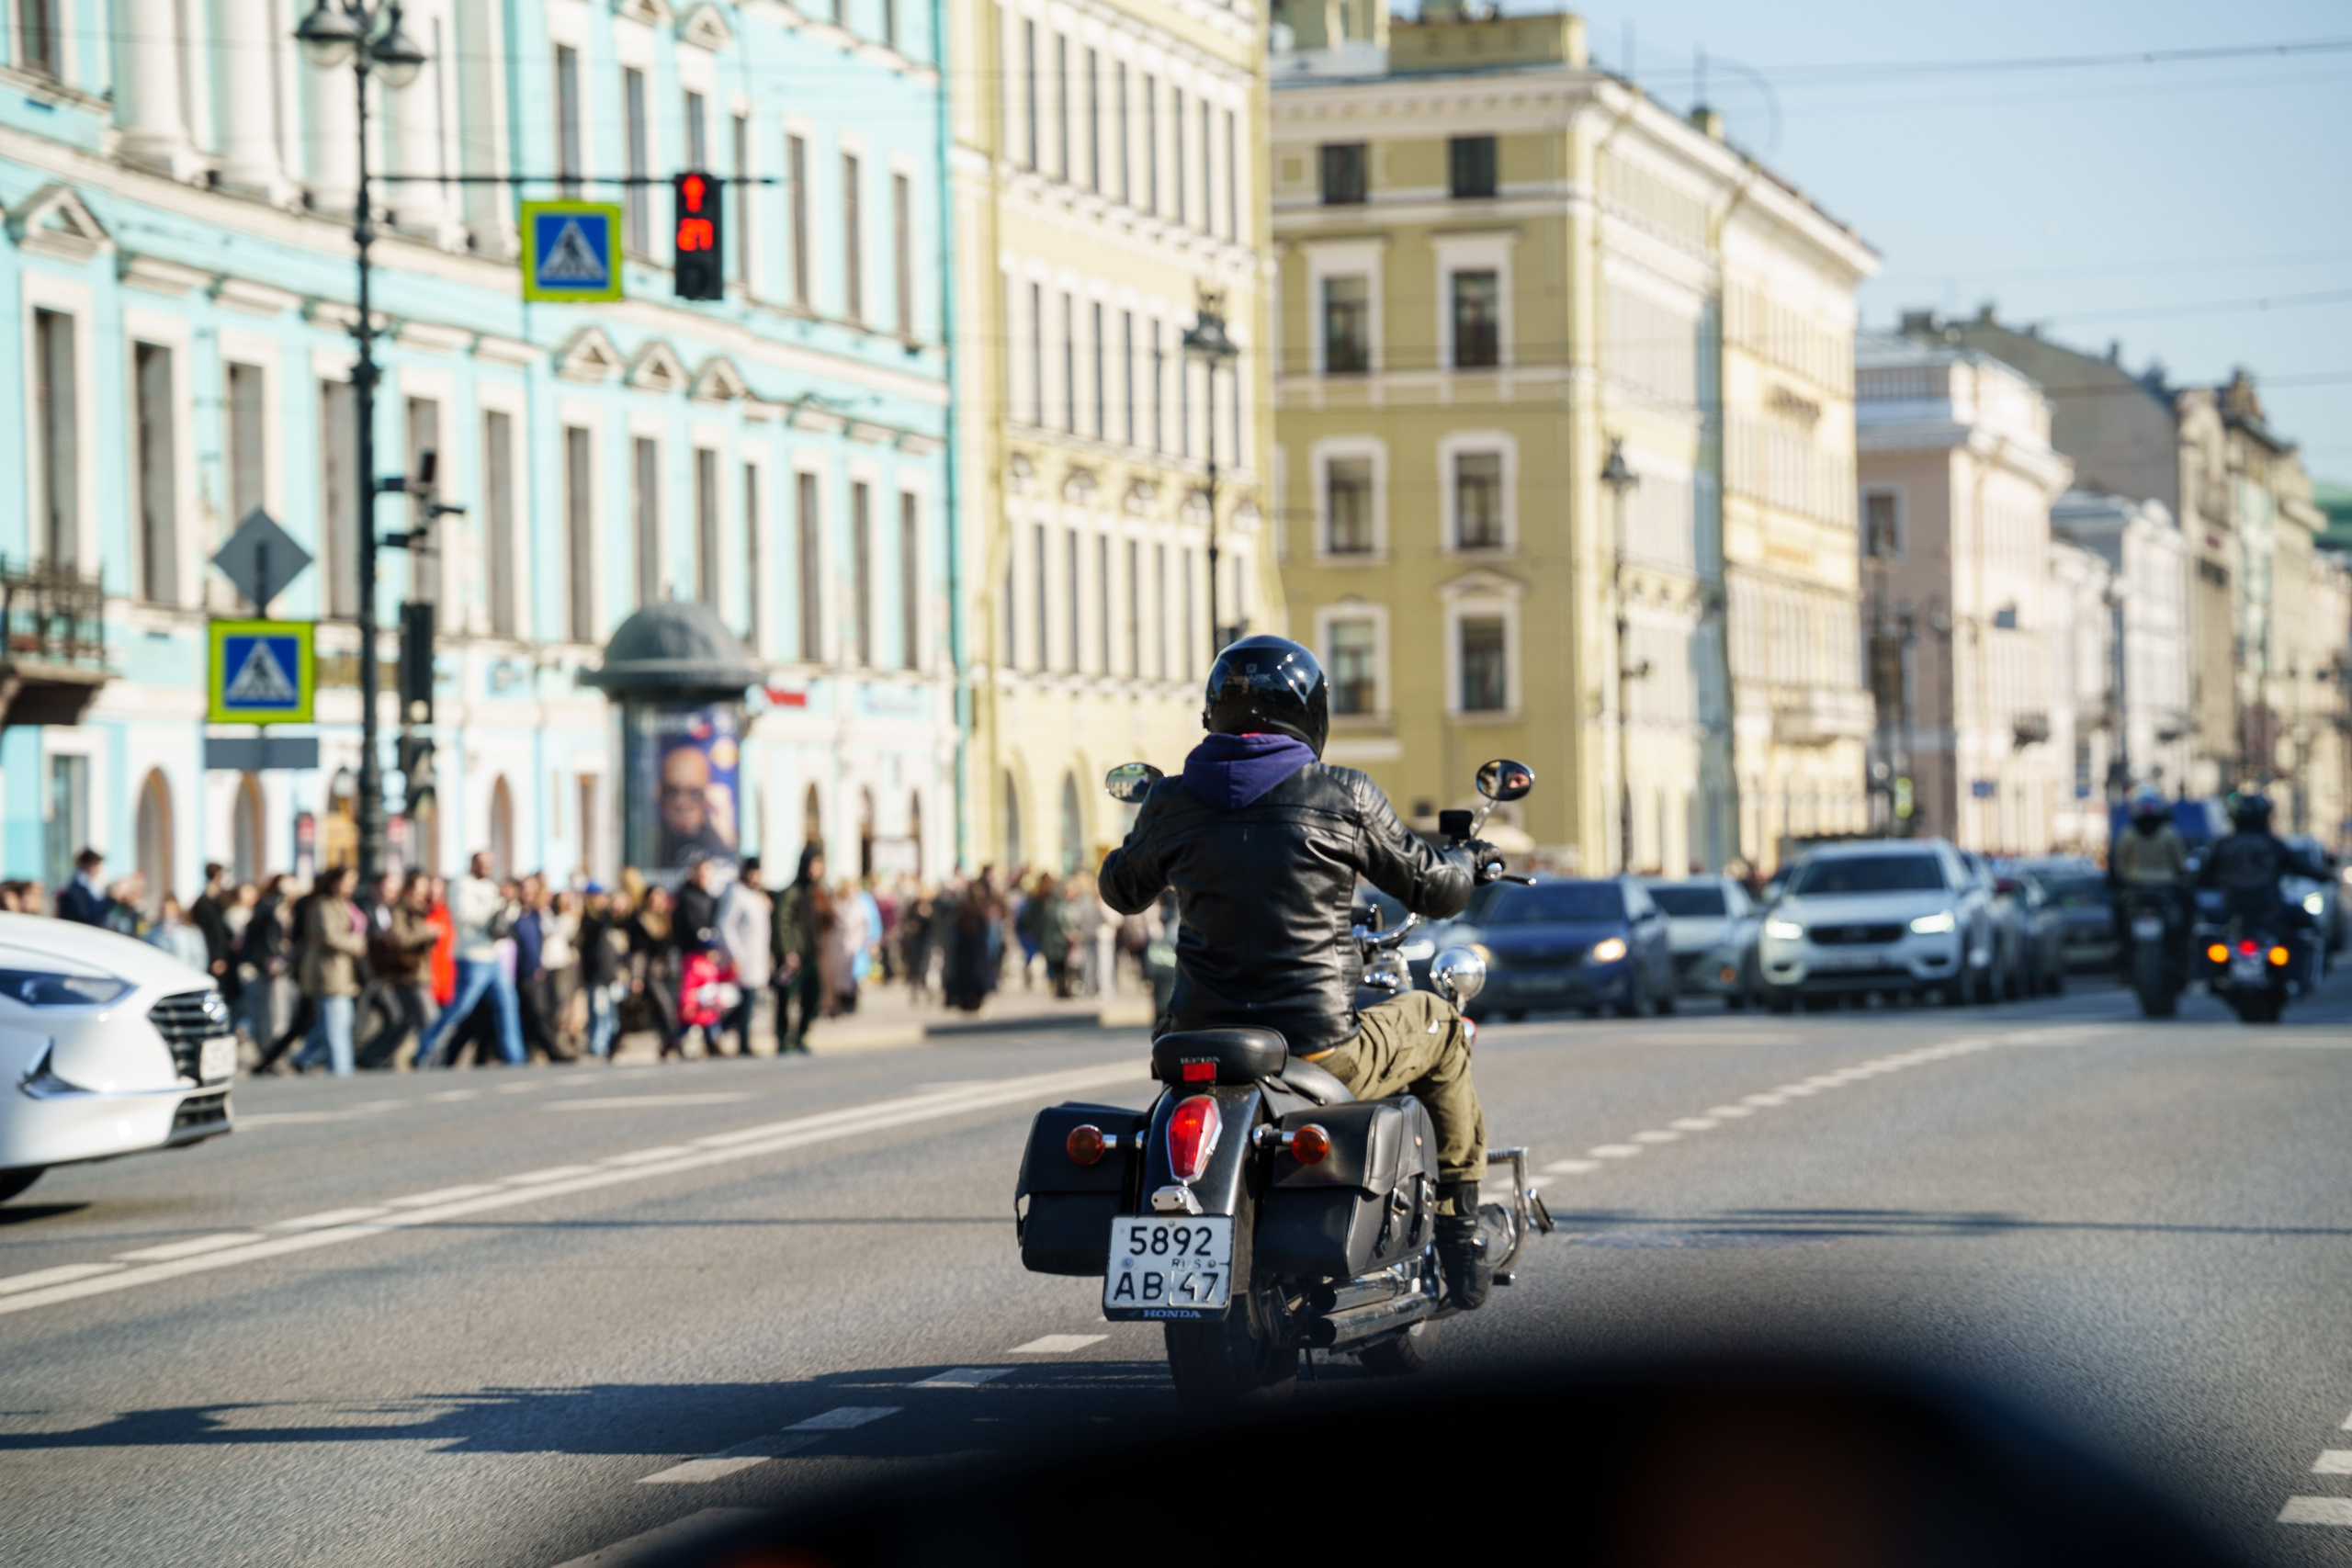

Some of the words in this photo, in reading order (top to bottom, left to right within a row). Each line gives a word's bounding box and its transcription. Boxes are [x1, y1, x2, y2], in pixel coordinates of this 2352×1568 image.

[1129, 1226, 1212, 1256] 5892
[1114, 1271, 1164, 1301] AB
[1179, 1272, 1219, 1302] 47
[1143, 1309, 1202, 1318] HONDA
